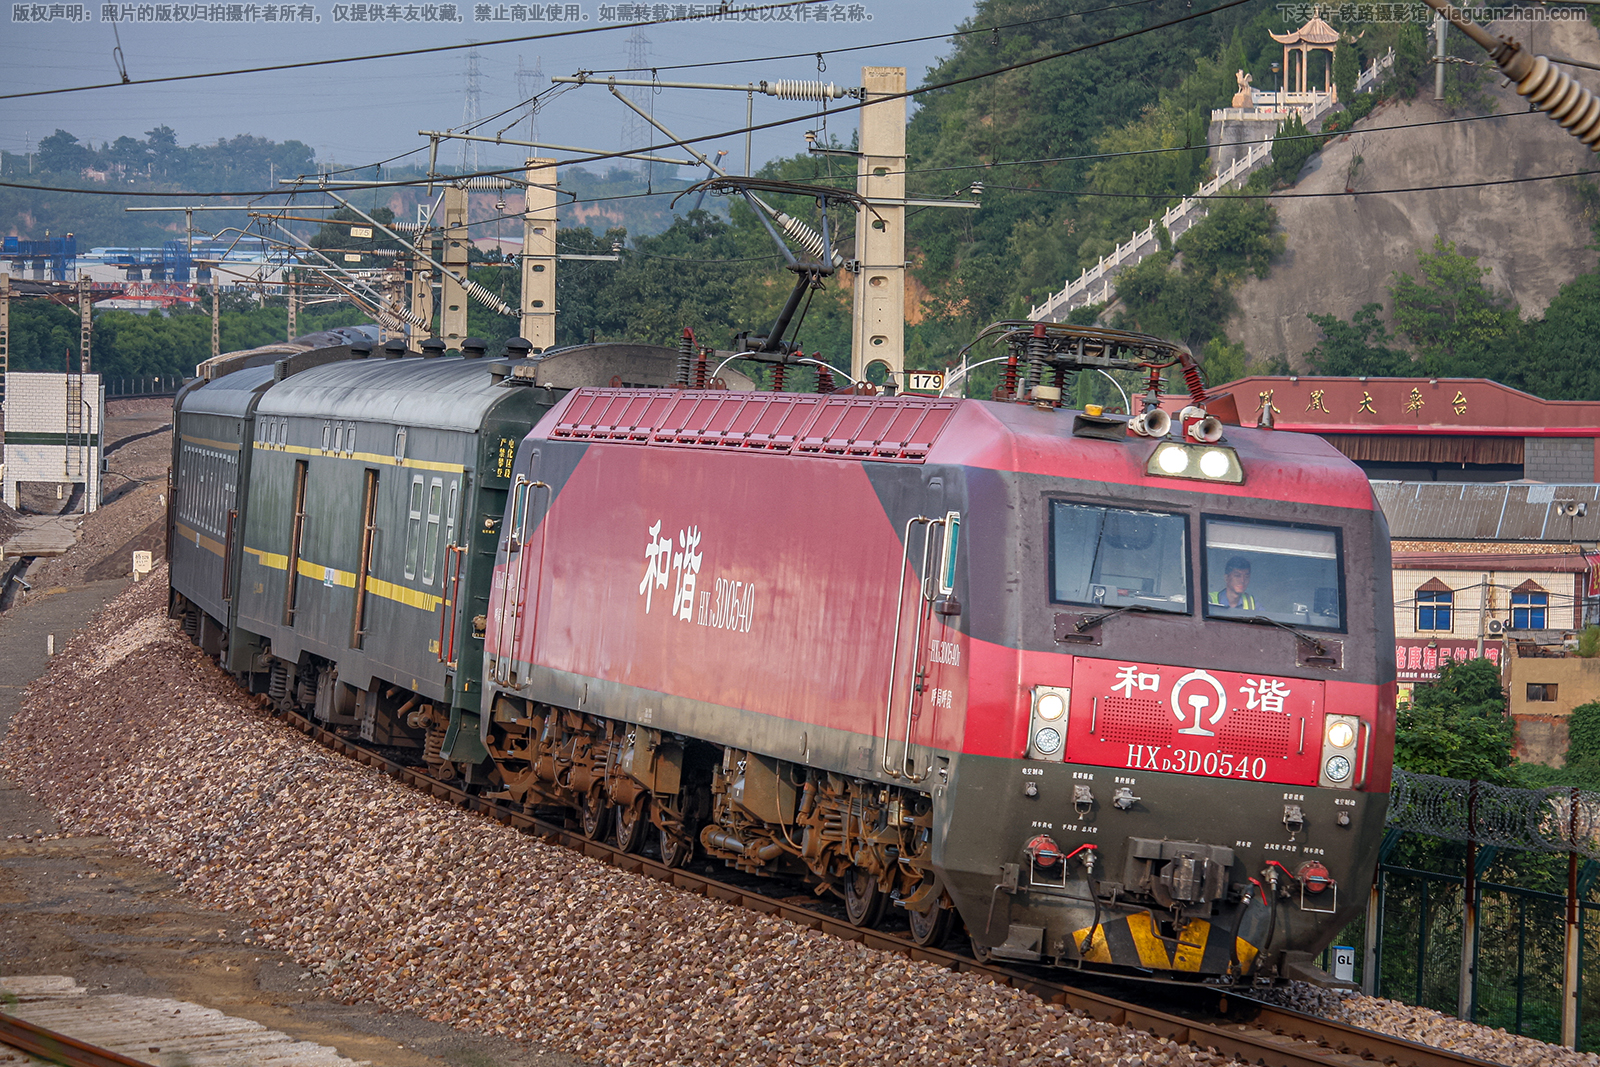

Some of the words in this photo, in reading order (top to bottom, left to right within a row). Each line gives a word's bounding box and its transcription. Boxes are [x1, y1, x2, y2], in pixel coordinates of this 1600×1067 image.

[914, 375, 942, 388] 179
[639, 519, 703, 623] 和谐
[1338, 955, 1352, 965] GL
